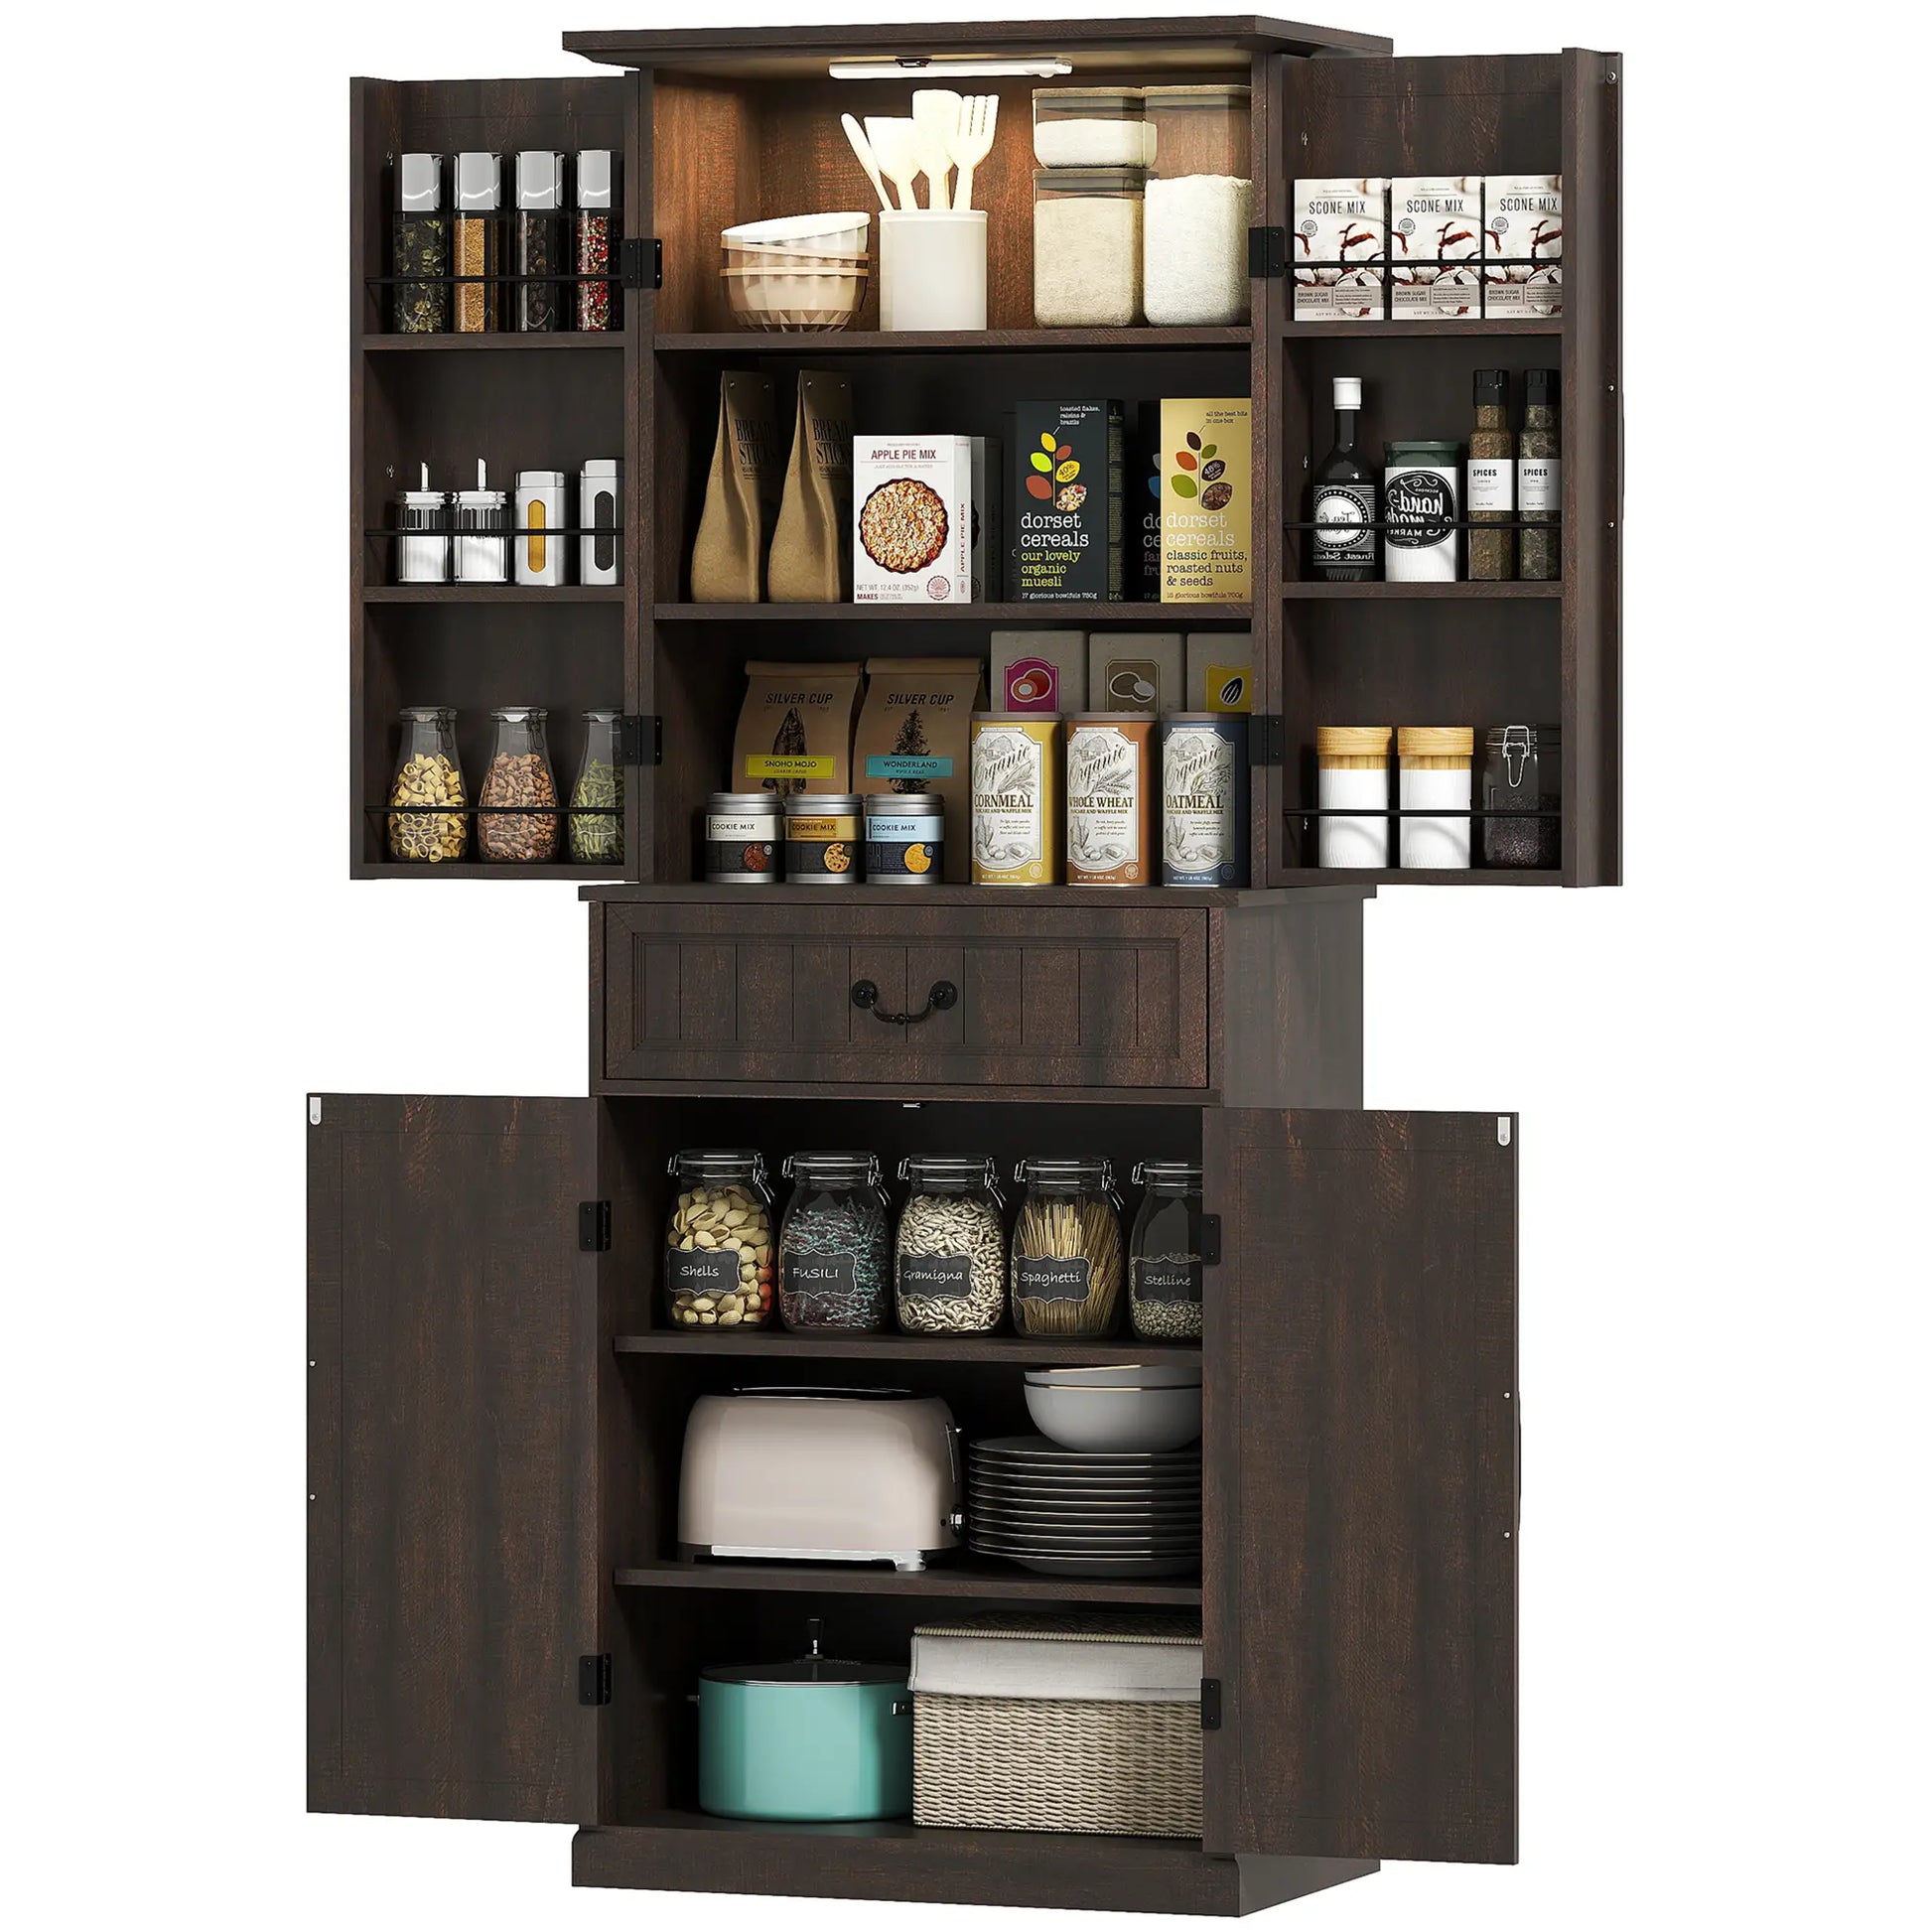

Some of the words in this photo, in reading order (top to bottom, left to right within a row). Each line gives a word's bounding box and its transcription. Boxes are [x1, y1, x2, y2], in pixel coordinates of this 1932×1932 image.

[1309, 201, 1343, 214] SCONE
[1346, 201, 1366, 214] MIX
[1406, 199, 1441, 213] SCONE
[1445, 199, 1464, 212] MIX
[1499, 198, 1534, 211] SCONE
[1538, 198, 1558, 211] MIX
[871, 449, 899, 460] APPLE
[902, 449, 916, 460] PIE
[919, 449, 936, 460] MIX
[1021, 512, 1082, 529] dorset
[1166, 511, 1227, 528] dorset
[1021, 530, 1090, 547] cereals
[1166, 530, 1235, 547] cereals
[1021, 551, 1043, 562] our
[1044, 549, 1081, 564] lovely
[1167, 549, 1207, 561] classic
[1210, 549, 1248, 562] fruits,
[1021, 563, 1067, 576] organic
[1167, 563, 1212, 574] roasted
[1215, 563, 1244, 574] nuts
[1021, 576, 1062, 588] muesli
[1167, 576, 1176, 587] &
[1179, 576, 1213, 587] seeds
[765, 693, 805, 704] SILVER
[808, 693, 834, 704] CUP
[887, 693, 926, 705] SILVER
[929, 693, 955, 705] CUP
[974, 744, 1031, 791] Organic
[1069, 744, 1126, 791] Organic
[1165, 745, 1222, 792] Organic
[975, 794, 1035, 808] CORNMEAL
[1097, 796, 1134, 808] WHEAT
[1166, 794, 1224, 809] OATMEAL
[679, 1264, 720, 1278] Shells
[902, 1269, 963, 1284] Gramigna
[1020, 1270, 1081, 1286] Spaghetti
[1144, 1275, 1191, 1287] Stelline
